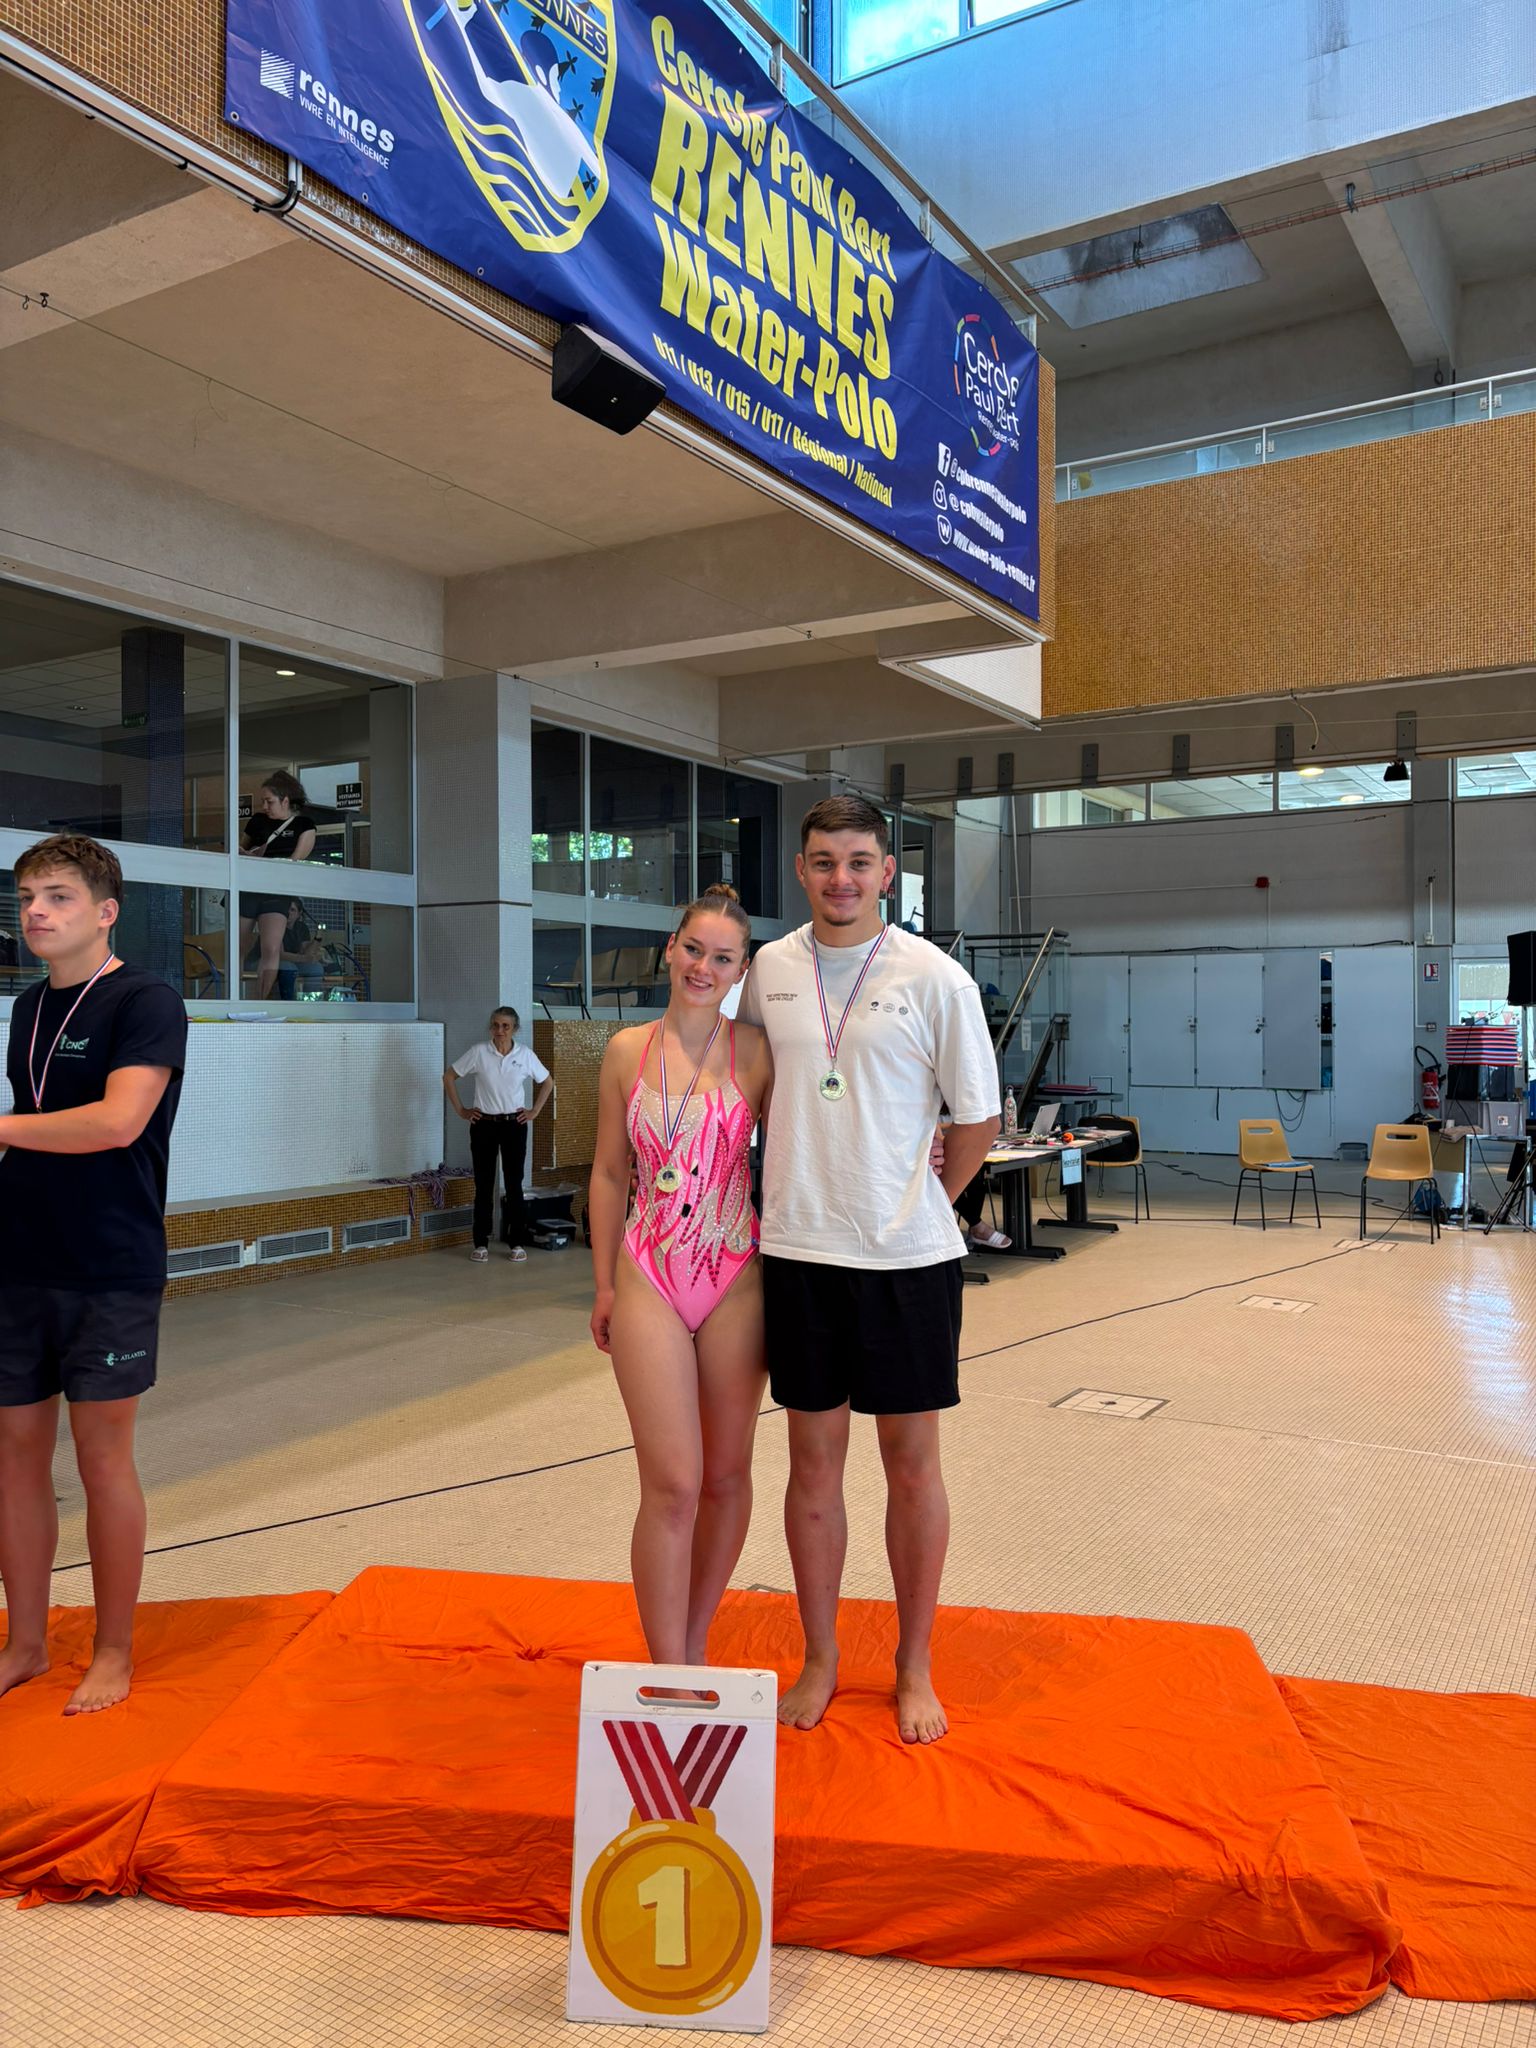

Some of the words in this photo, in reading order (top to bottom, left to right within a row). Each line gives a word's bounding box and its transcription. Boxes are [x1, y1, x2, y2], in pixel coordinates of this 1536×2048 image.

[532, 0, 606, 55] NNES
[300, 69, 395, 152] rennes
[300, 94, 323, 120] VIVRE
[326, 114, 336, 129] EN
[338, 124, 390, 169] INTELLIGENCE
[651, 15, 766, 166] Cercle
[770, 122, 836, 230] Paul
[837, 187, 897, 284] Bert
[651, 83, 894, 380] RENNES
[653, 212, 897, 459] Water-Polo
[964, 332, 1019, 407] Cercle
[652, 332, 680, 371] U11
[687, 358, 714, 397] U13
[725, 383, 750, 421] U15
[761, 406, 784, 441] U17
[792, 425, 848, 477] Régional
[855, 461, 893, 508] National
[966, 372, 995, 416] Paul
[996, 395, 1020, 436] Bert
[65, 1041, 85, 1050] CNC
[638, 1865, 688, 1968] 1
